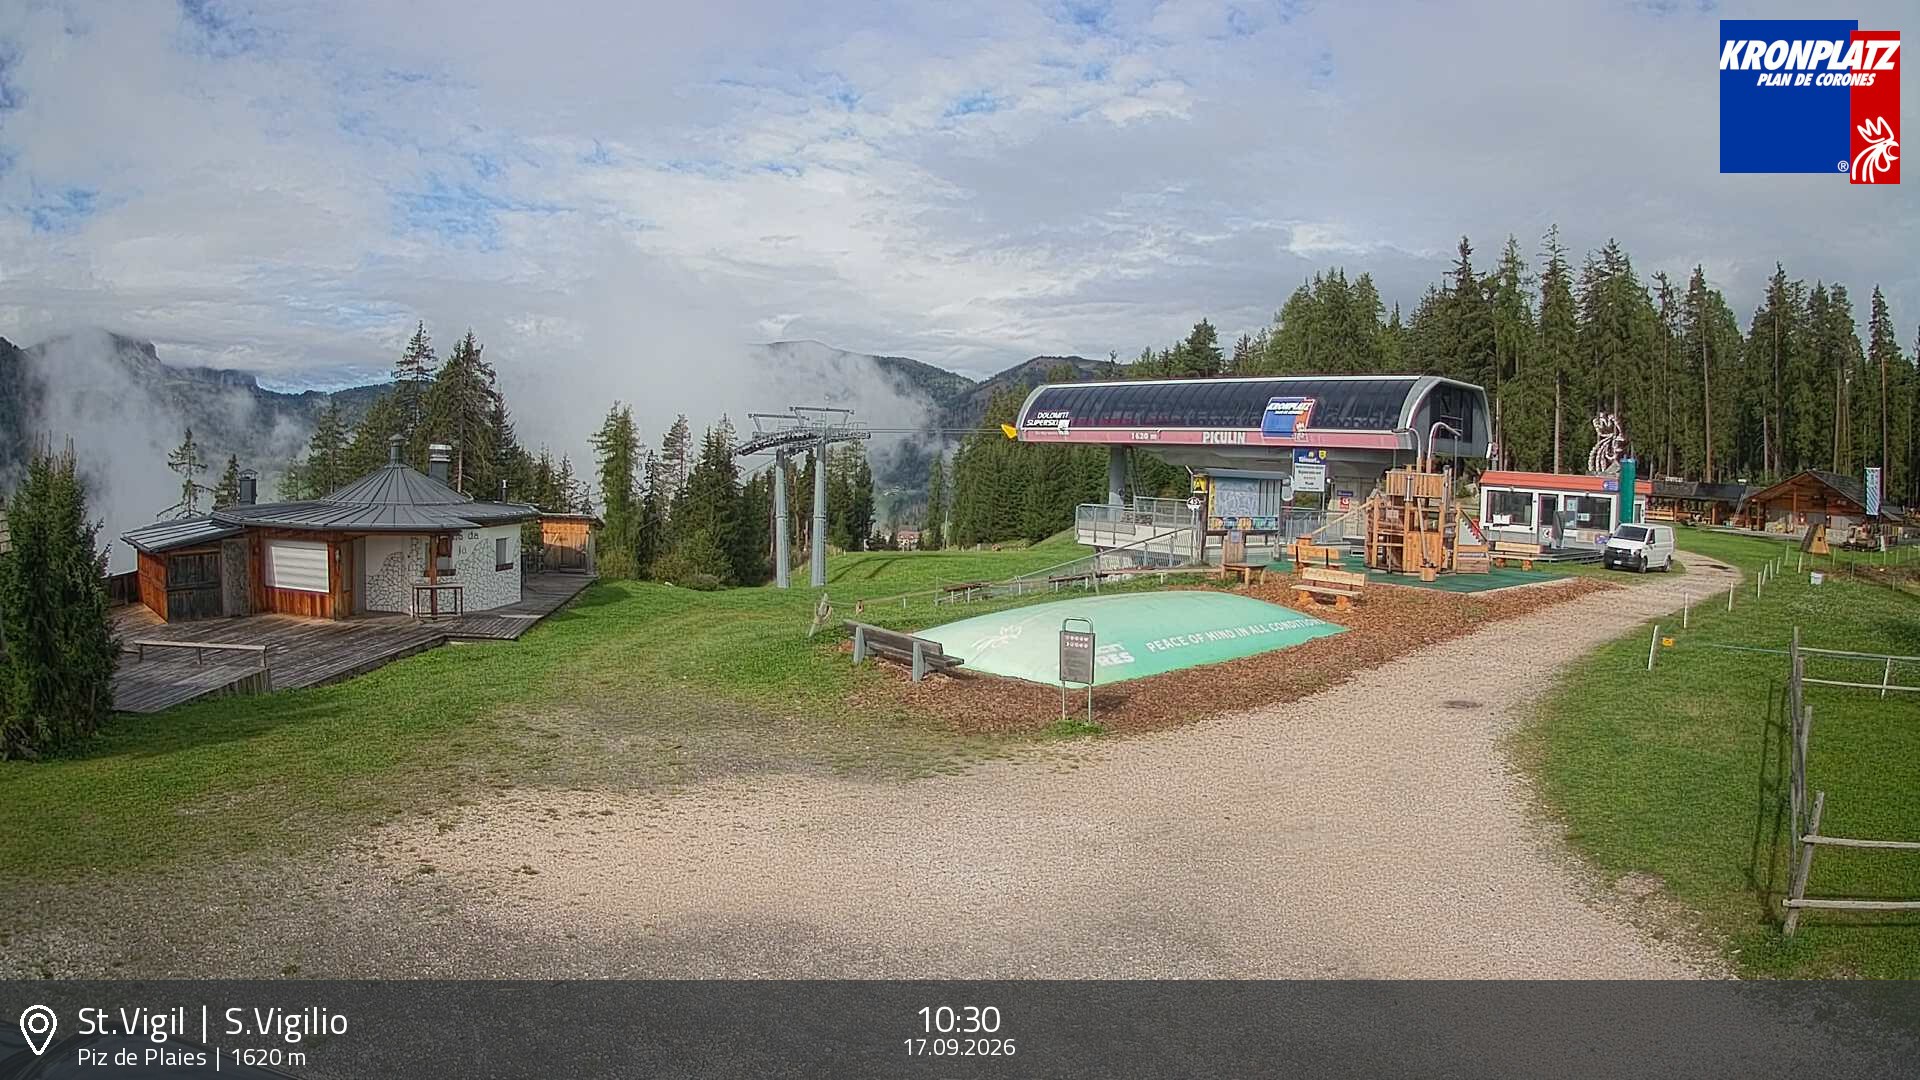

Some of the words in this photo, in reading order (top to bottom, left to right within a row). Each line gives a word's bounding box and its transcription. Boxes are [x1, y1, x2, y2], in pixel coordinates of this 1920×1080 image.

[1131, 432, 1149, 440] 1620
[1202, 431, 1246, 445] PICULIN
[1146, 634, 1189, 652] PEACE
[1189, 632, 1206, 644] OF
[1205, 628, 1234, 641] MIND
[1233, 626, 1250, 638] IN
[1248, 624, 1269, 635] ALL
